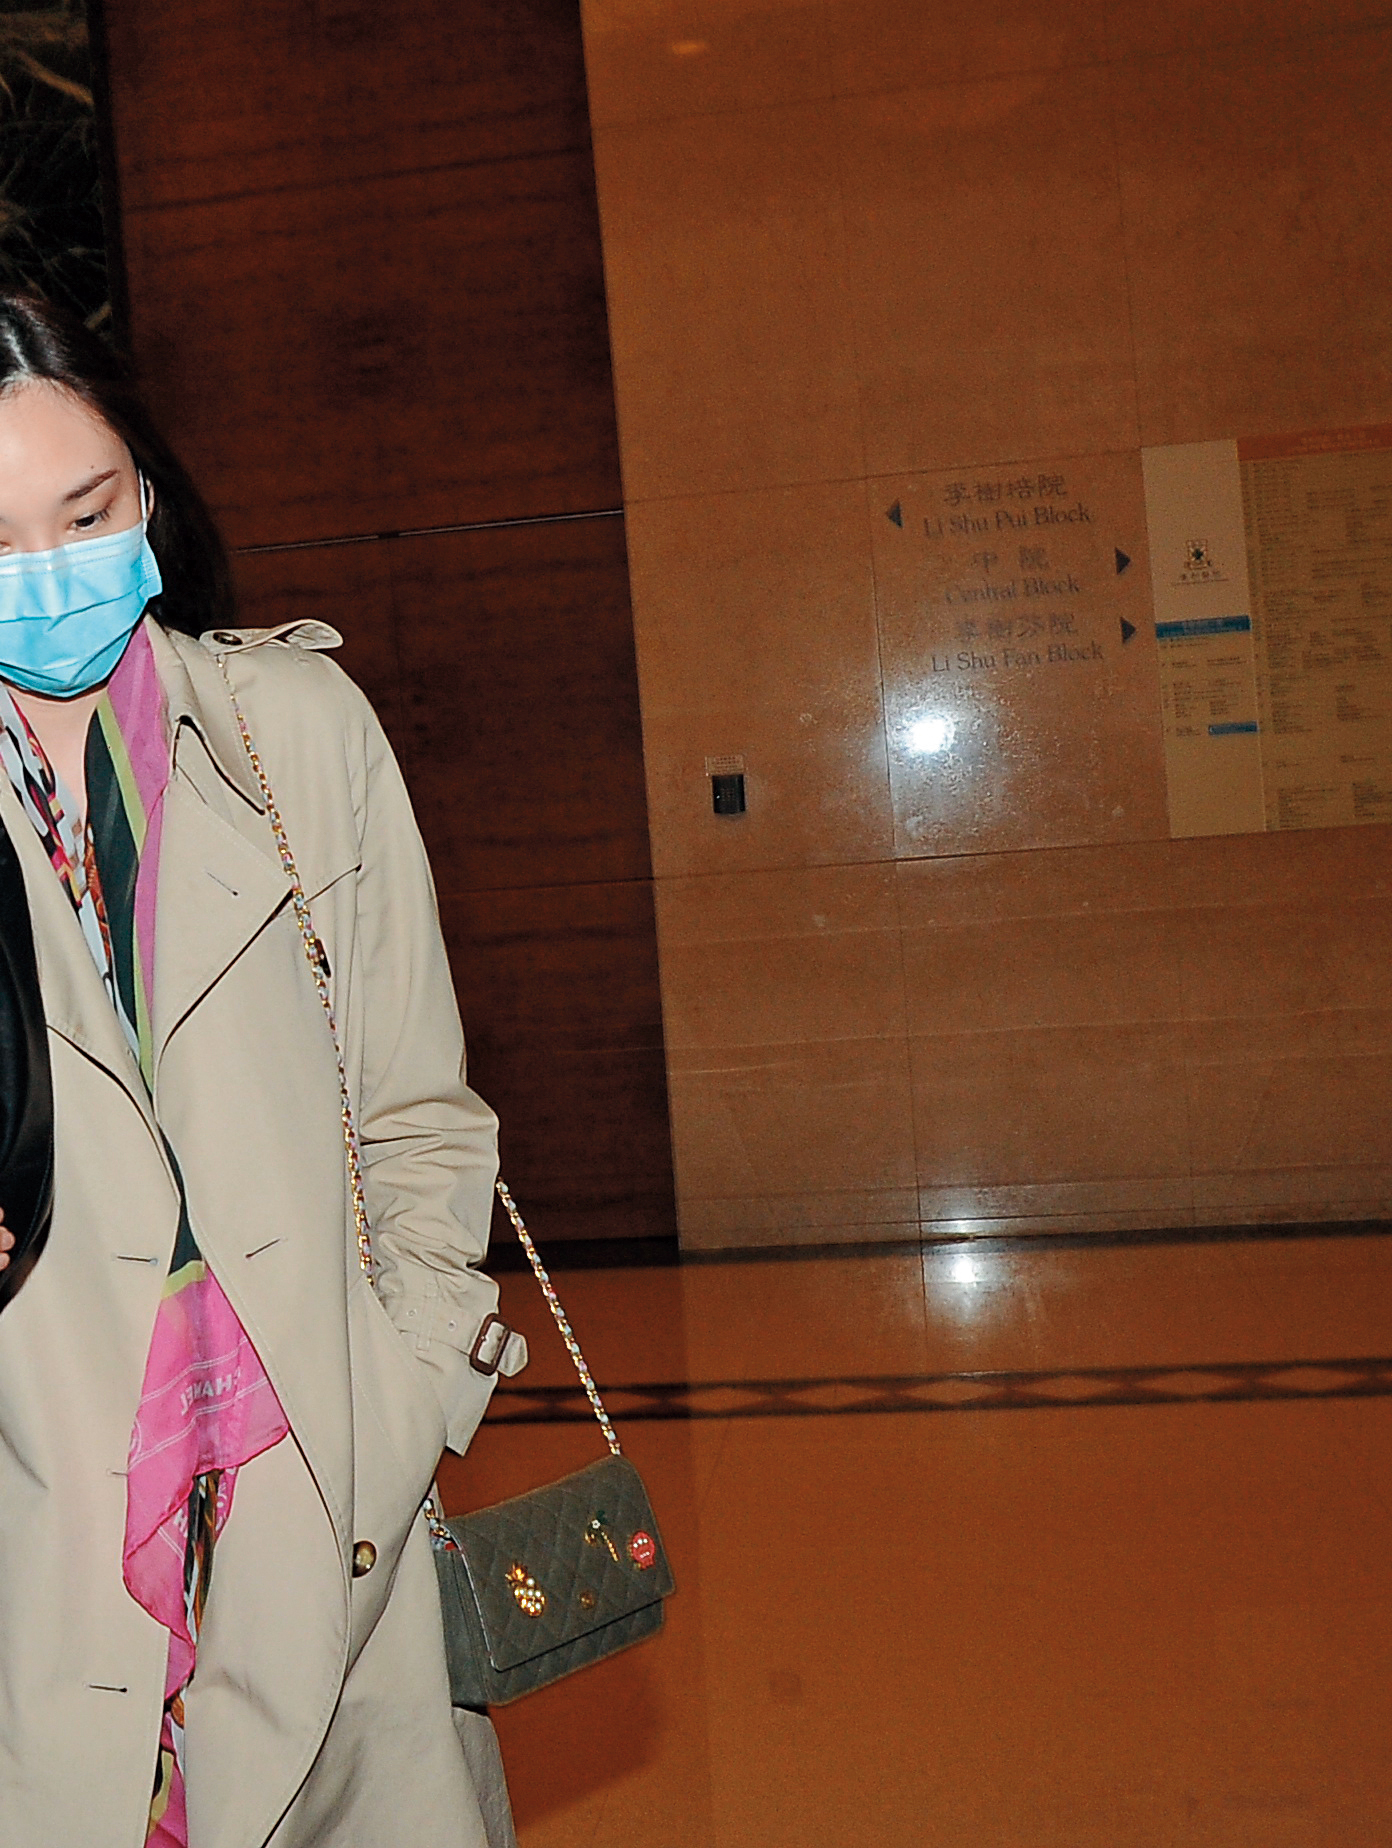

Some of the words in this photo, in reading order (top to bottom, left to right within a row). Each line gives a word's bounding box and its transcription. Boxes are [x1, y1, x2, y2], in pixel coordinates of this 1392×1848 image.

[950, 513, 989, 535] Shu
[995, 509, 1029, 532] Pui
[1034, 502, 1091, 526] Block
[1023, 574, 1080, 598] Block
[931, 655, 951, 673] Li
[957, 651, 996, 671] Shu
[1003, 648, 1041, 668] Fan
[1047, 640, 1104, 664] Block
